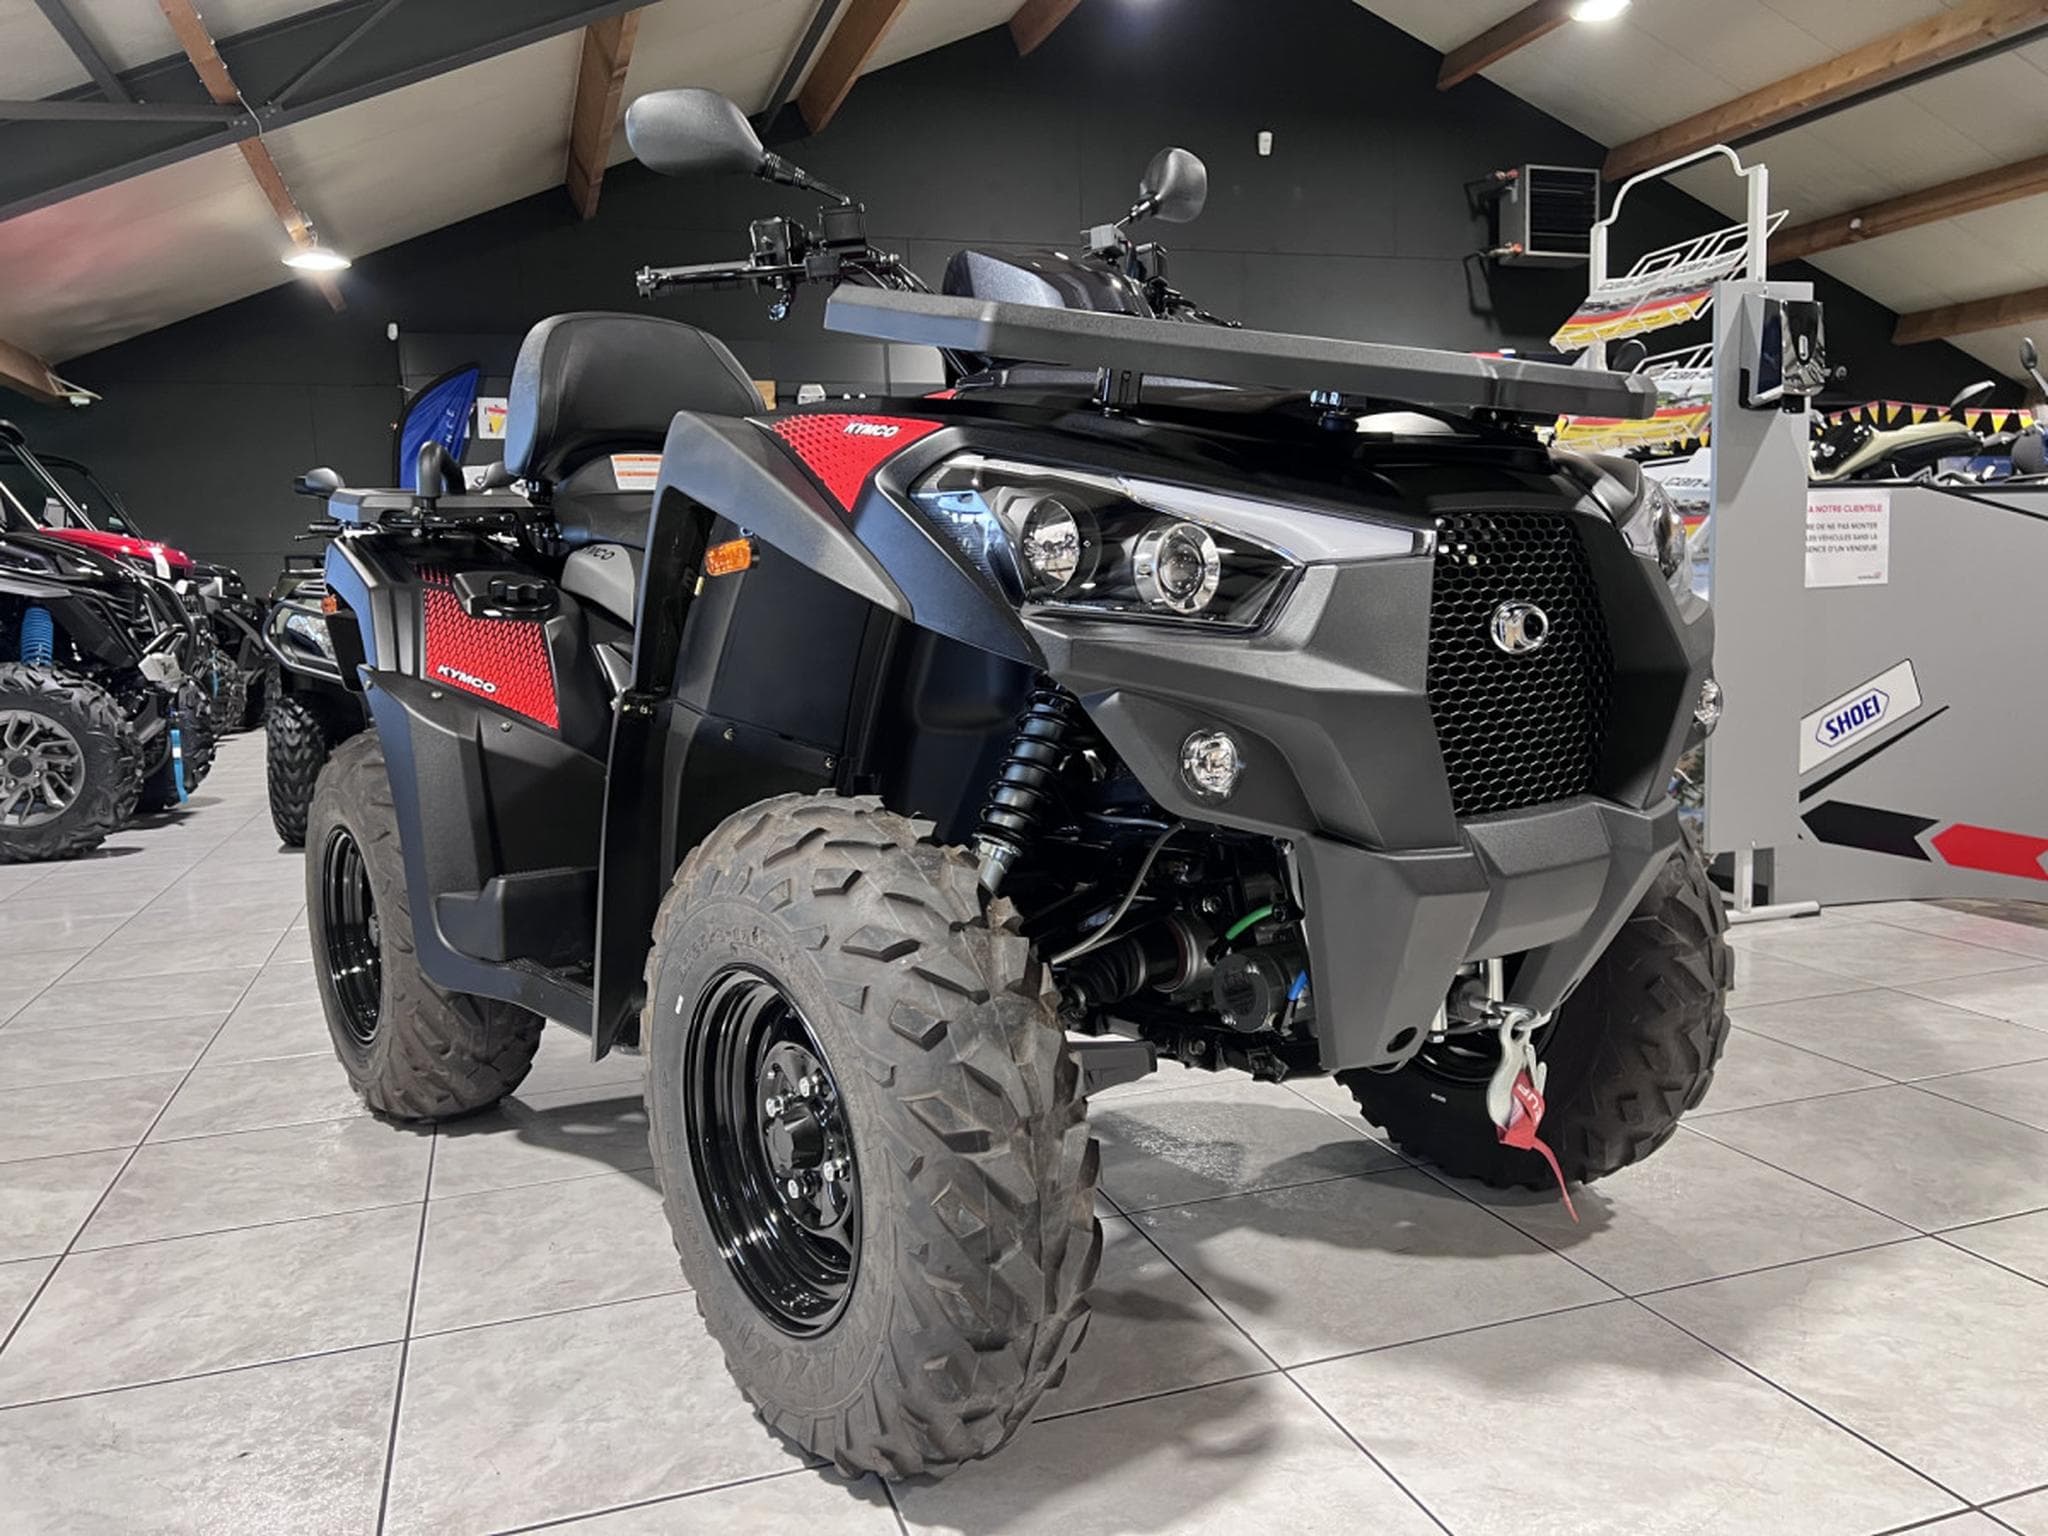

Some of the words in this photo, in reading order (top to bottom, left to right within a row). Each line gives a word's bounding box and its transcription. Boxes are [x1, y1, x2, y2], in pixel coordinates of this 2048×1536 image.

[843, 422, 900, 437] KYMCO
[1815, 504, 1842, 512] NOTRE
[436, 665, 497, 693] KYMCO
[1825, 694, 1880, 740] SHOEI
